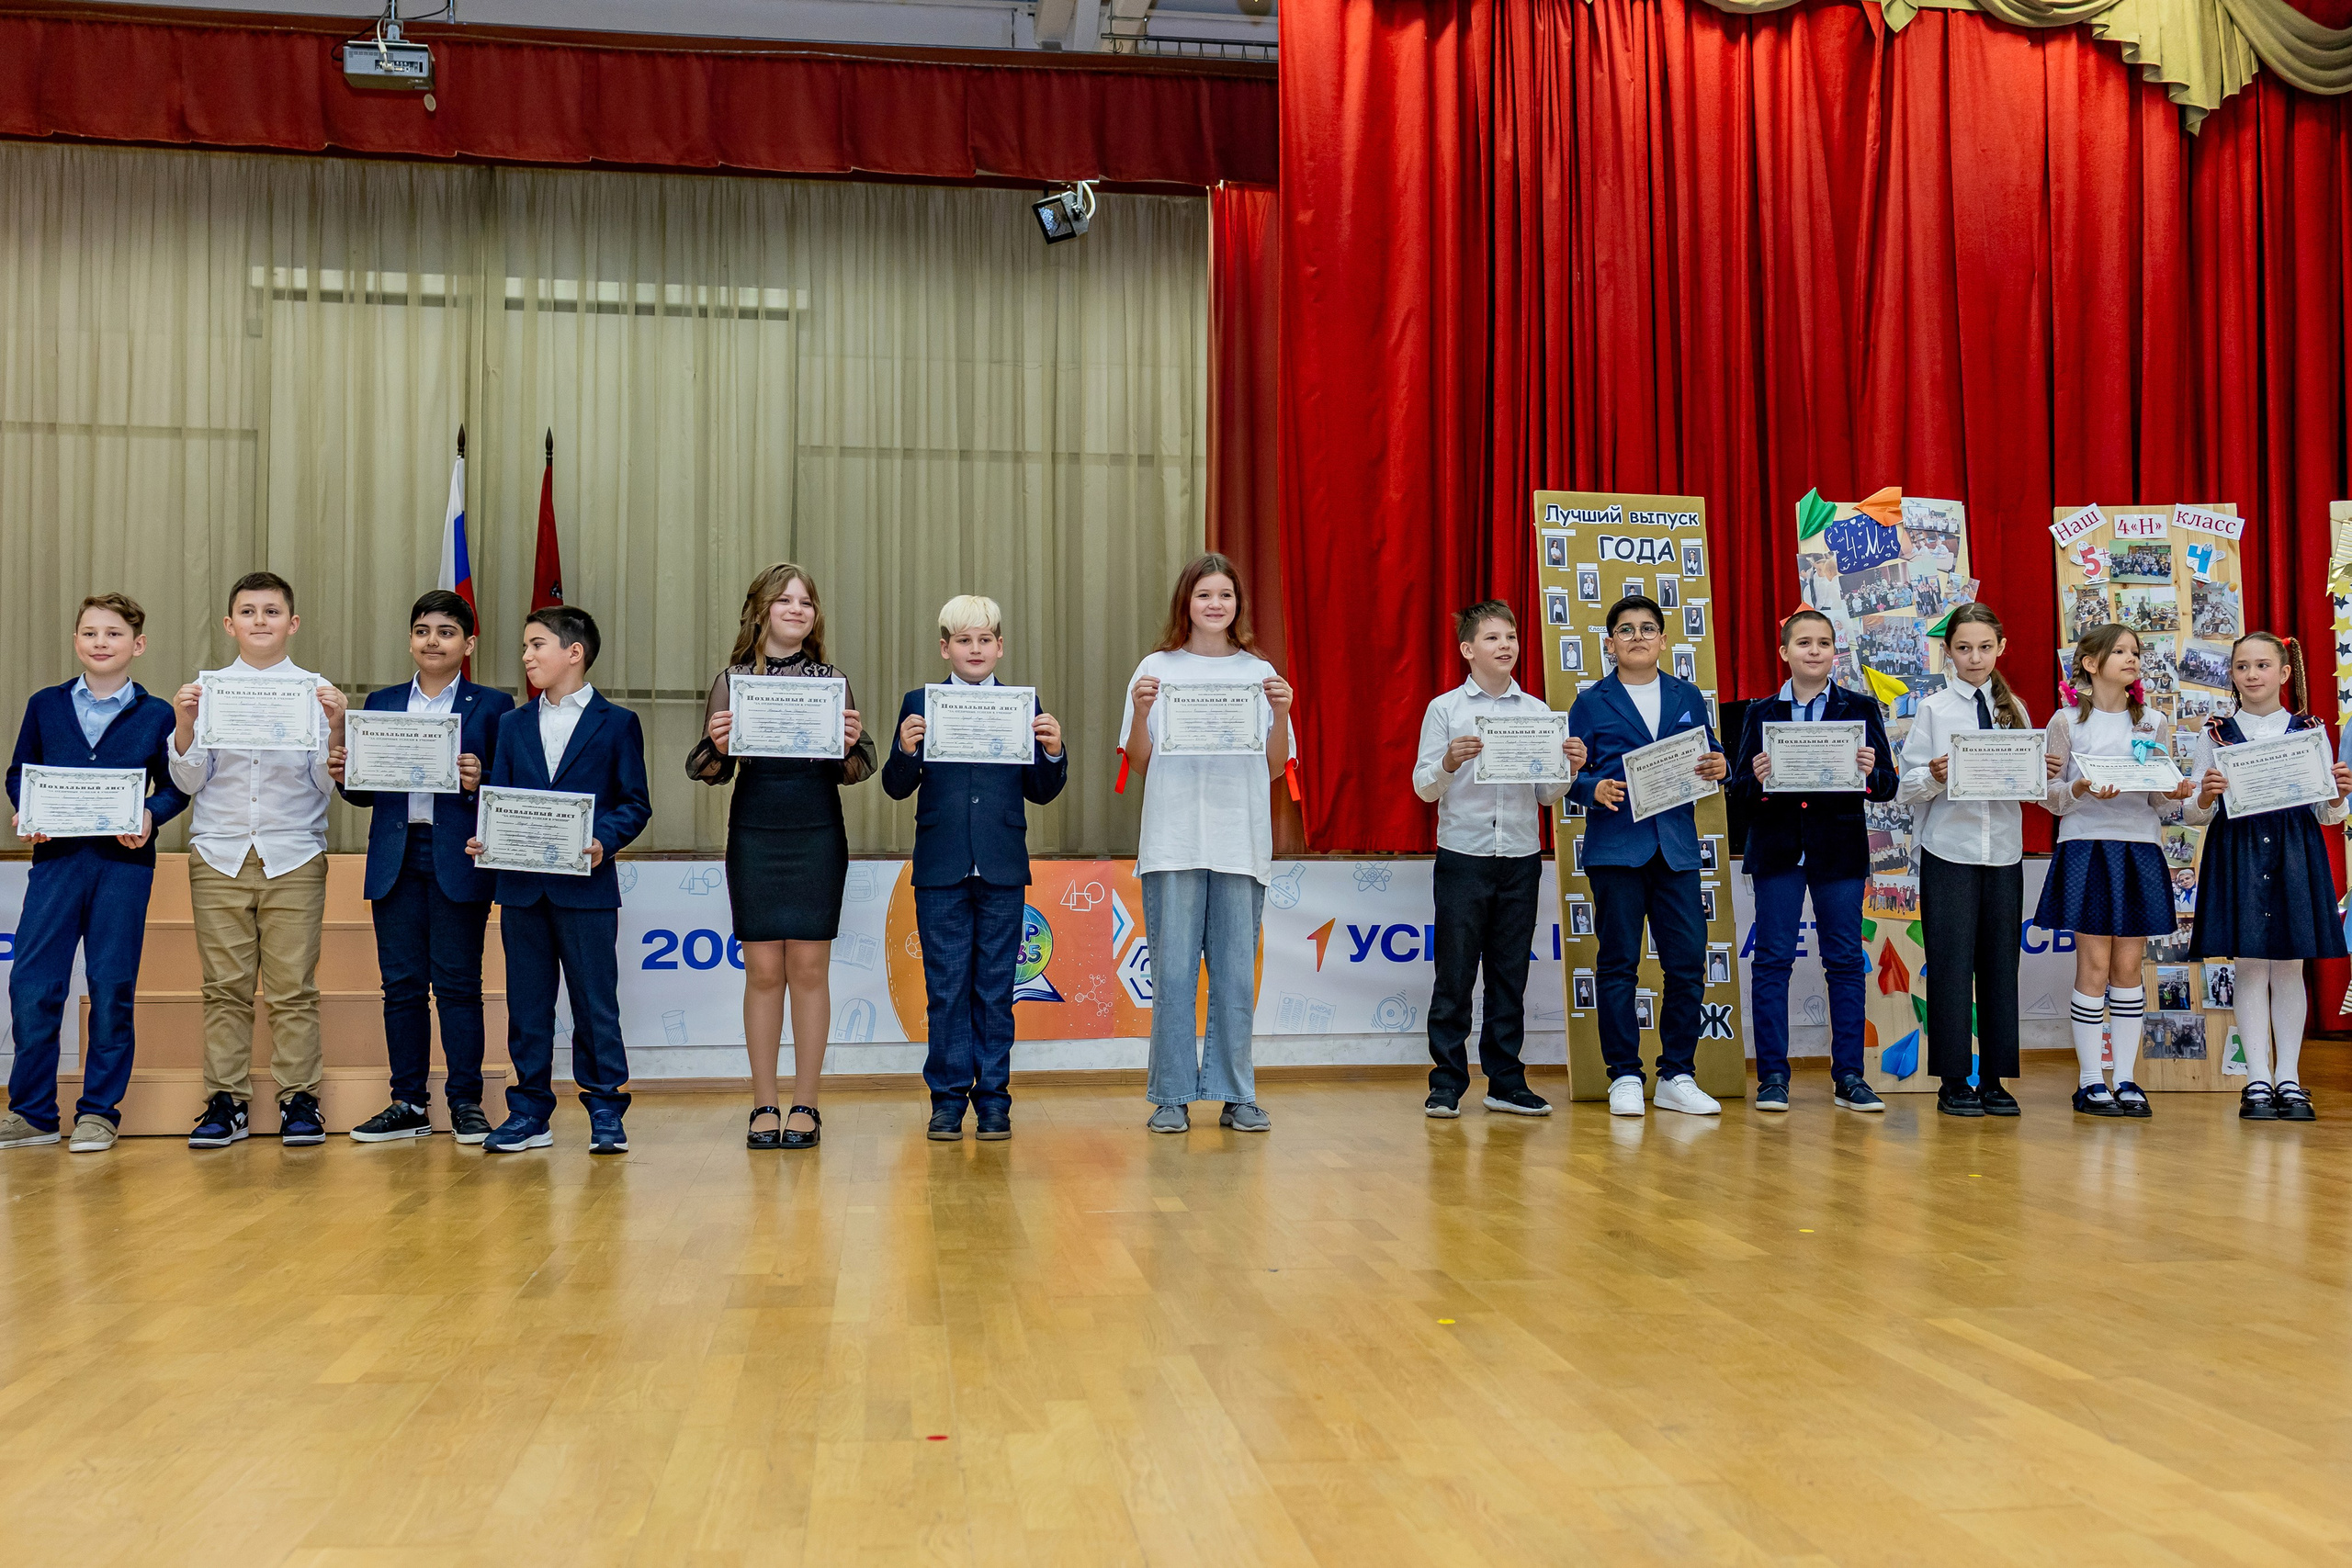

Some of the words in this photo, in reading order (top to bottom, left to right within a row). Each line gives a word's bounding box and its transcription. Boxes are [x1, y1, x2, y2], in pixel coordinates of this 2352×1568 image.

[1545, 504, 1622, 526] Лучший
[1630, 512, 1699, 530] выпуск
[2054, 510, 2099, 541] Наш
[2176, 510, 2236, 534] класс
[1599, 536, 1675, 564] ГОДА
[1699, 1004, 1734, 1038] Ж
